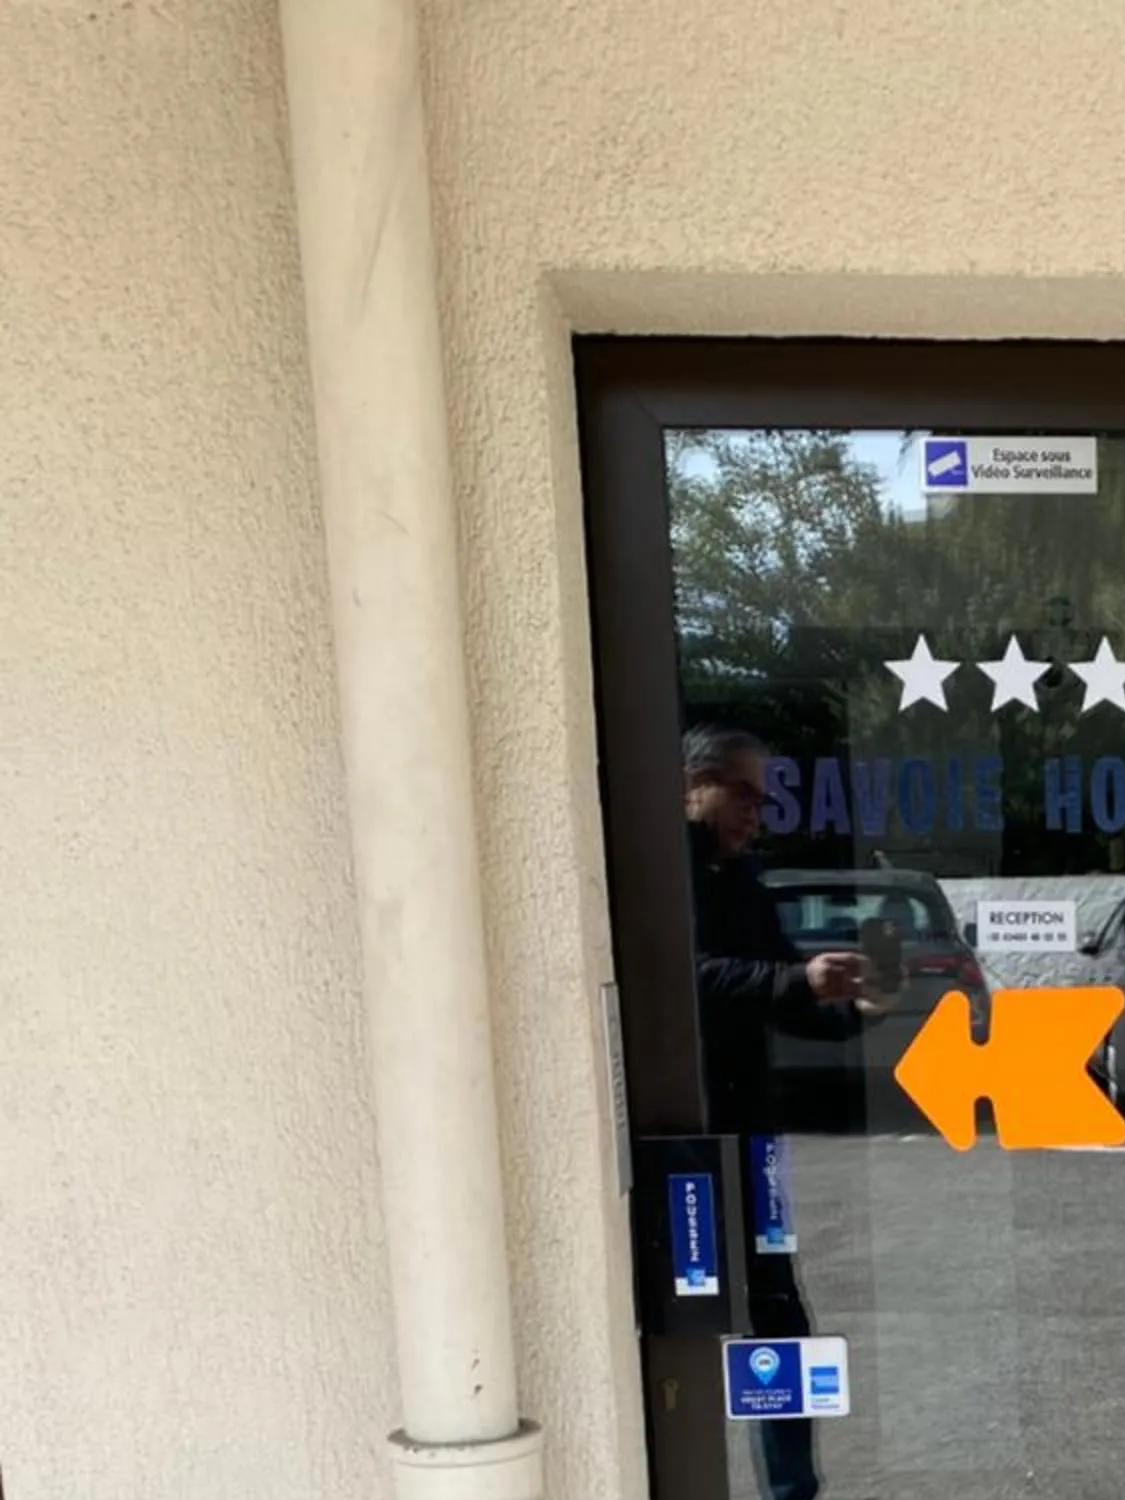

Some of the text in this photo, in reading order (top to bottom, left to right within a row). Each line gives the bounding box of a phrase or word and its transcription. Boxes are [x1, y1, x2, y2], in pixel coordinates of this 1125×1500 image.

[992, 448, 1071, 464] Espace sous
[1013, 464, 1092, 479] Surveillance
[762, 756, 1005, 836] SAVOIE
[990, 911, 1064, 925] RECEPTION
